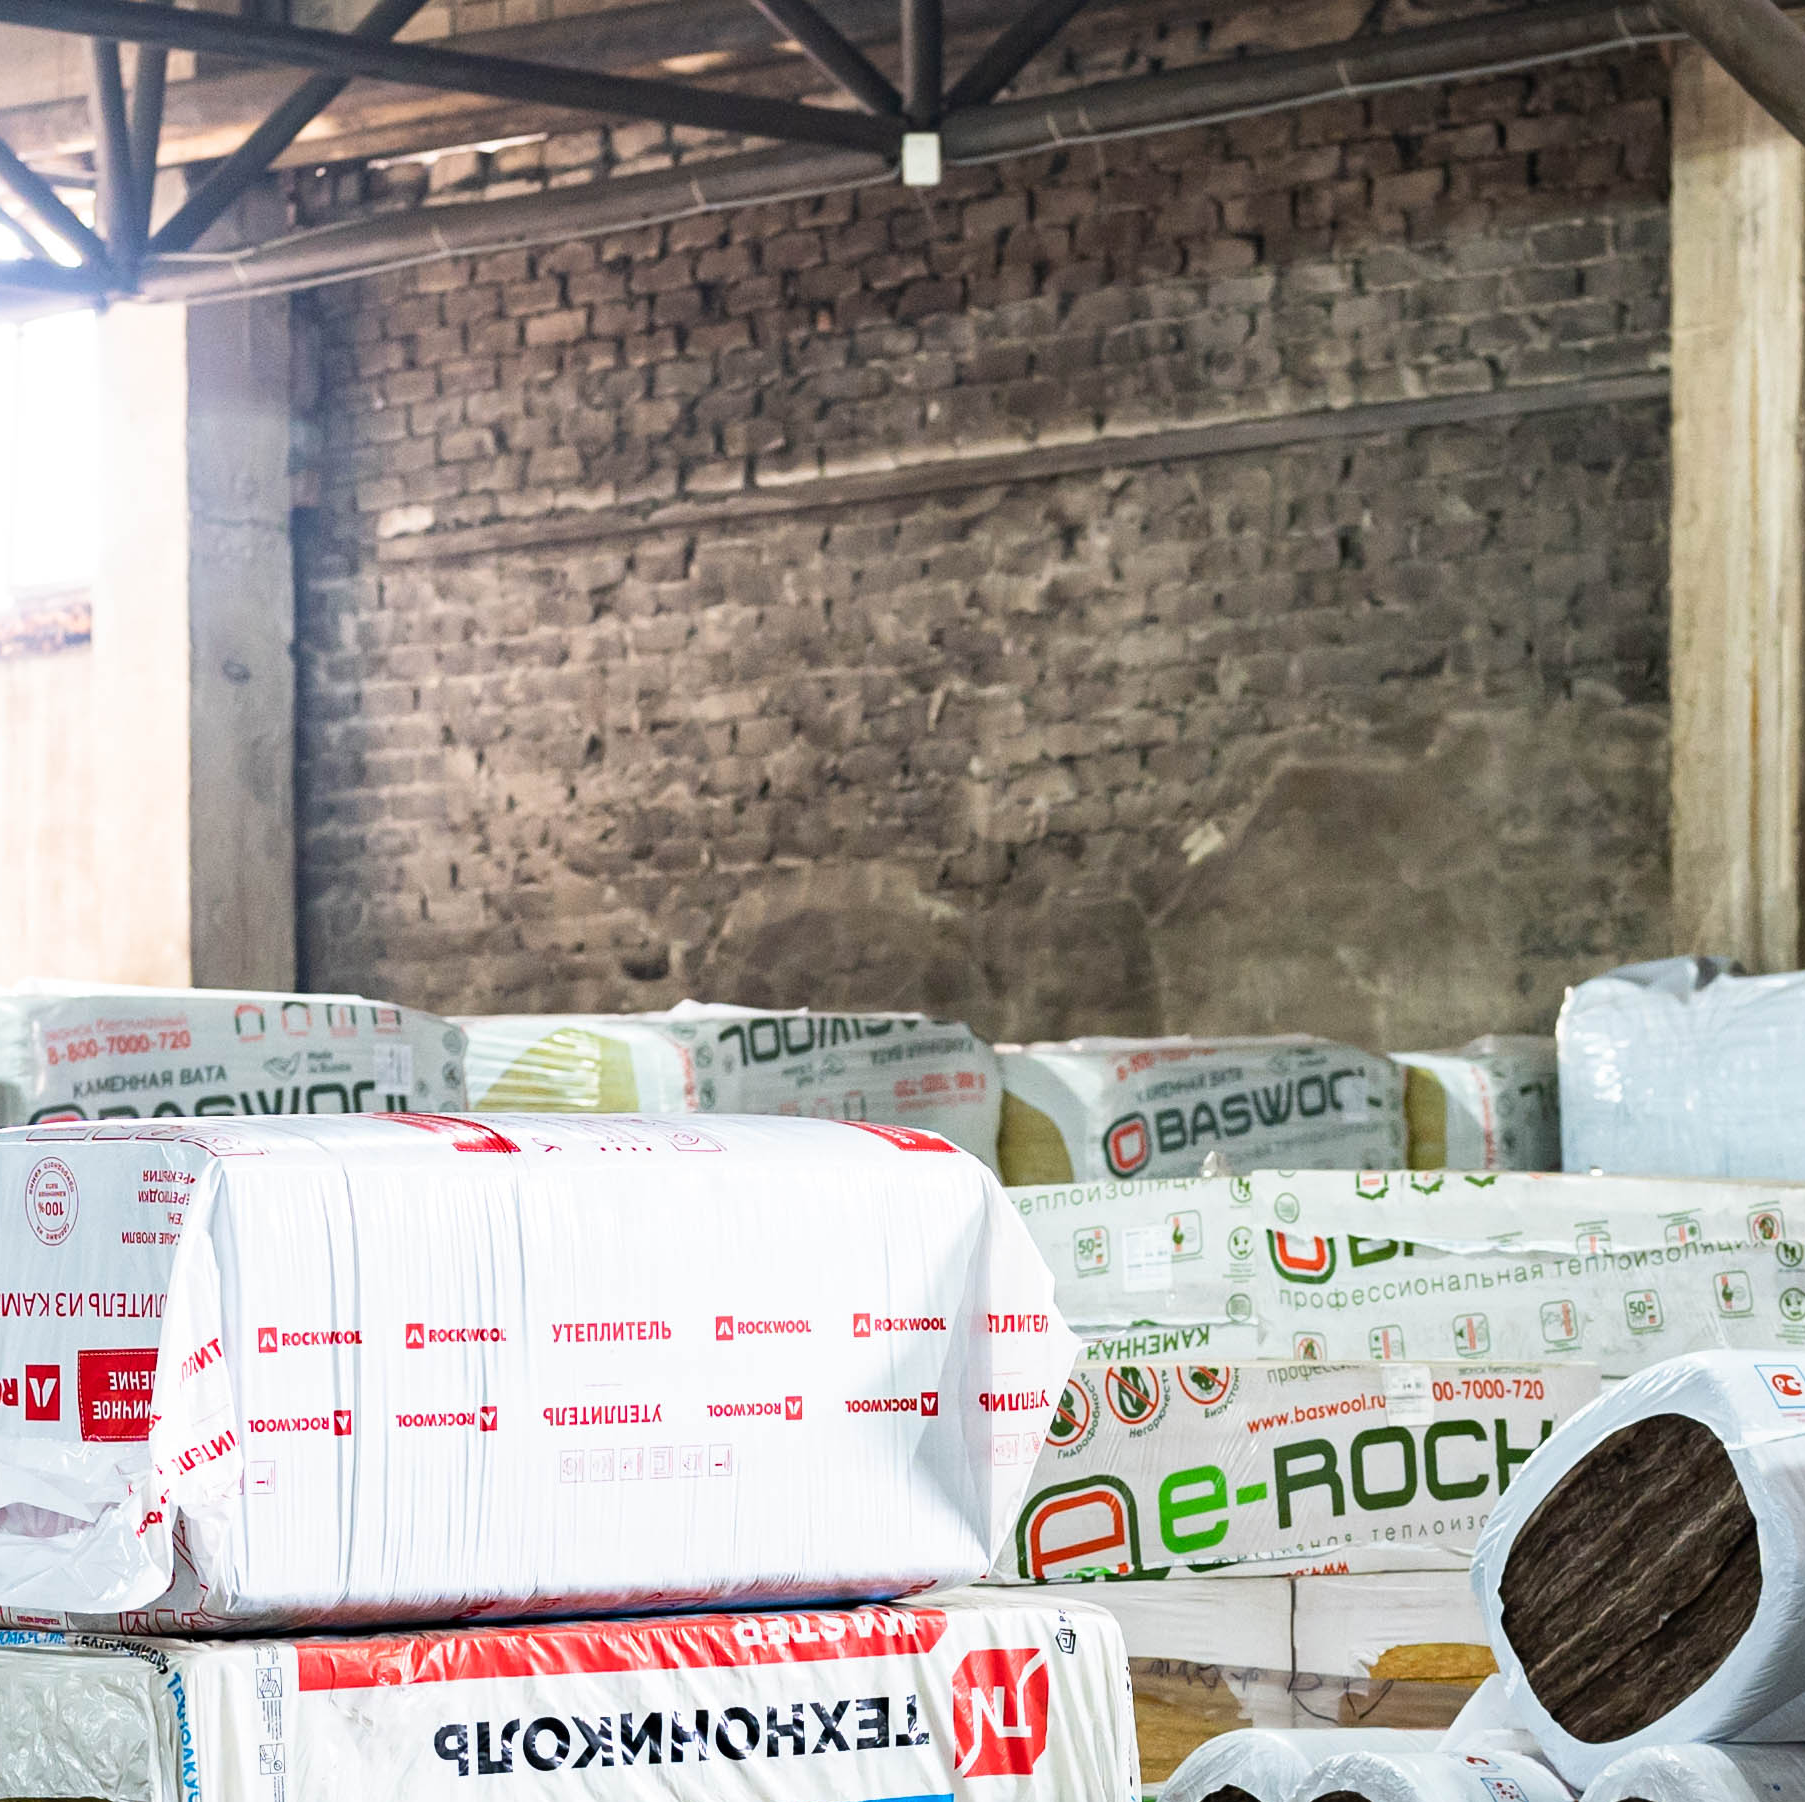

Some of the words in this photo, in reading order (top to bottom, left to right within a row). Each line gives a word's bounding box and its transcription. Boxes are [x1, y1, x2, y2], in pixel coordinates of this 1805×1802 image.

[177, 1063, 228, 1089] ВАТА
[1156, 1067, 1383, 1153] BASWOO
[1278, 1261, 1545, 1311] профессиональная
[55, 1293, 84, 1318] ИЗ
[86, 1292, 169, 1318] ЛИТЕЛЬ
[551, 1320, 672, 1344] УТЕПЛИТЕЛЬ
[737, 1318, 812, 1335] ROCKWOOL
[873, 1316, 947, 1333] ROCKWOOL
[281, 1329, 363, 1347] ROCKWOOL
[1432, 1378, 1546, 1403] 00-7000-720
[542, 1403, 663, 1426] УТЕПЛИТЕЛЬ
[706, 1402, 783, 1419] ROCKWOOL
[844, 1397, 919, 1414] ROCKWOOL
[248, 1416, 331, 1434] ROCKWOOL
[395, 1412, 476, 1429] ROCKWOOL
[1369, 1514, 1490, 1543] теплоизо
[433, 1696, 932, 1778] ТЕХНОНИКОЛЬ
